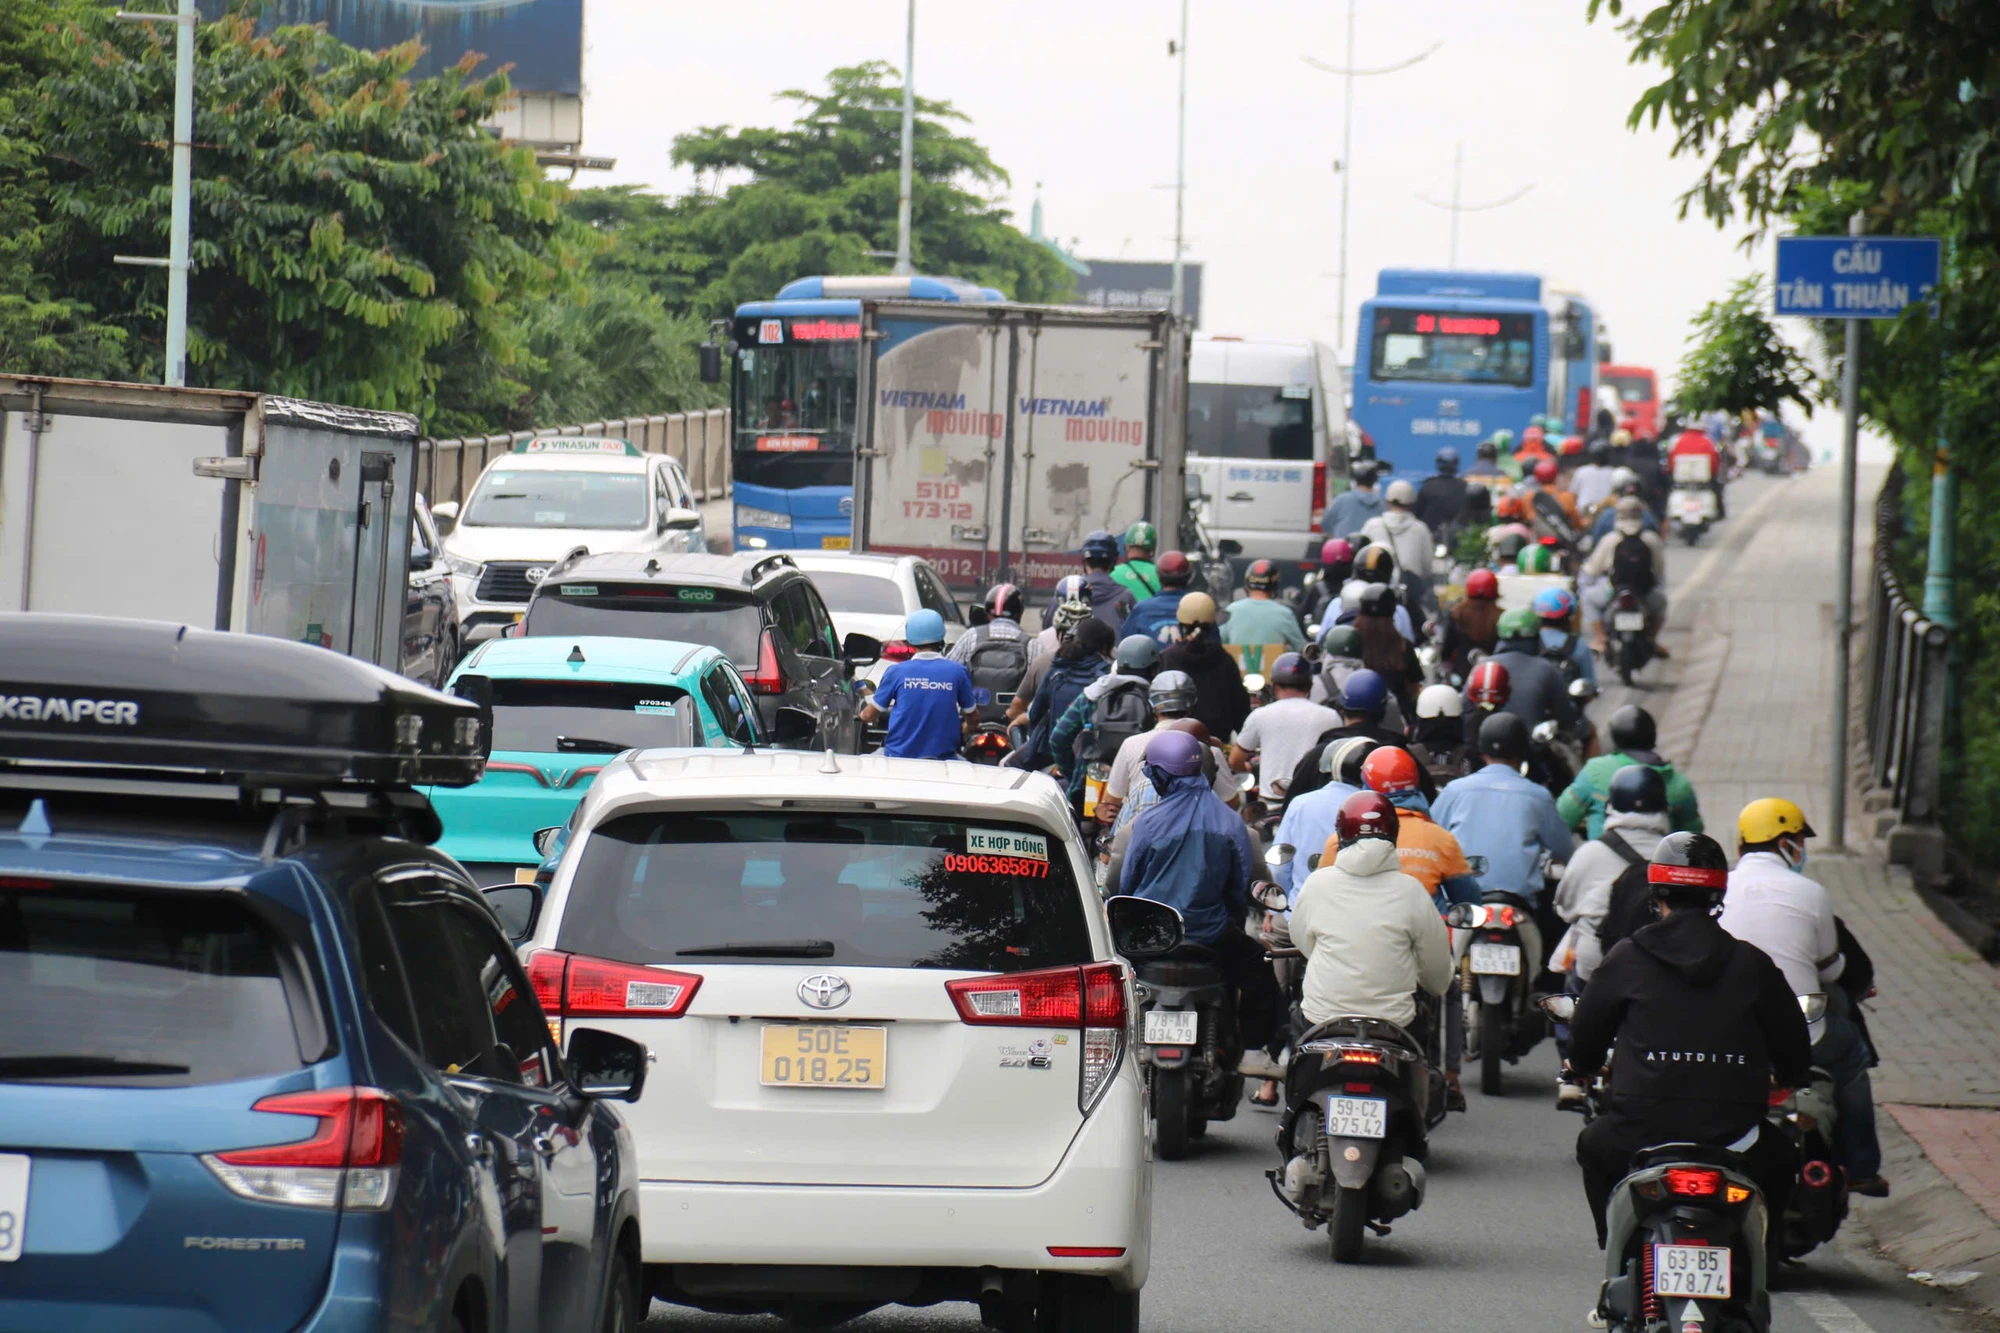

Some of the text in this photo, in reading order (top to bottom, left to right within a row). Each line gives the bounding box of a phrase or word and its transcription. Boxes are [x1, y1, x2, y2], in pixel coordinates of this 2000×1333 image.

[1778, 276, 1823, 309] TÂN
[763, 323, 780, 342] 102
[880, 390, 965, 409] VIETNAM
[1020, 398, 1106, 417] VIETNAM
[926, 408, 1004, 439] moving
[1065, 416, 1144, 447] moving
[552, 440, 623, 451] VINASUN TAXI
[916, 481, 960, 500] 51D
[679, 589, 714, 600] Grab
[971, 835, 984, 848] XE
[988, 836, 1011, 852] HỢP
[944, 854, 1049, 878] 0906365877
[797, 1028, 849, 1054] 50E
[1149, 1028, 1192, 1042] 034.79
[774, 1057, 871, 1083] 018.25
[1337, 1100, 1378, 1117] 59-C2
[1330, 1117, 1382, 1136] 875.42
[184, 1236, 306, 1250] FORESTER
[1667, 1250, 1719, 1271] 63-B5
[1660, 1272, 1726, 1295] 678.74
